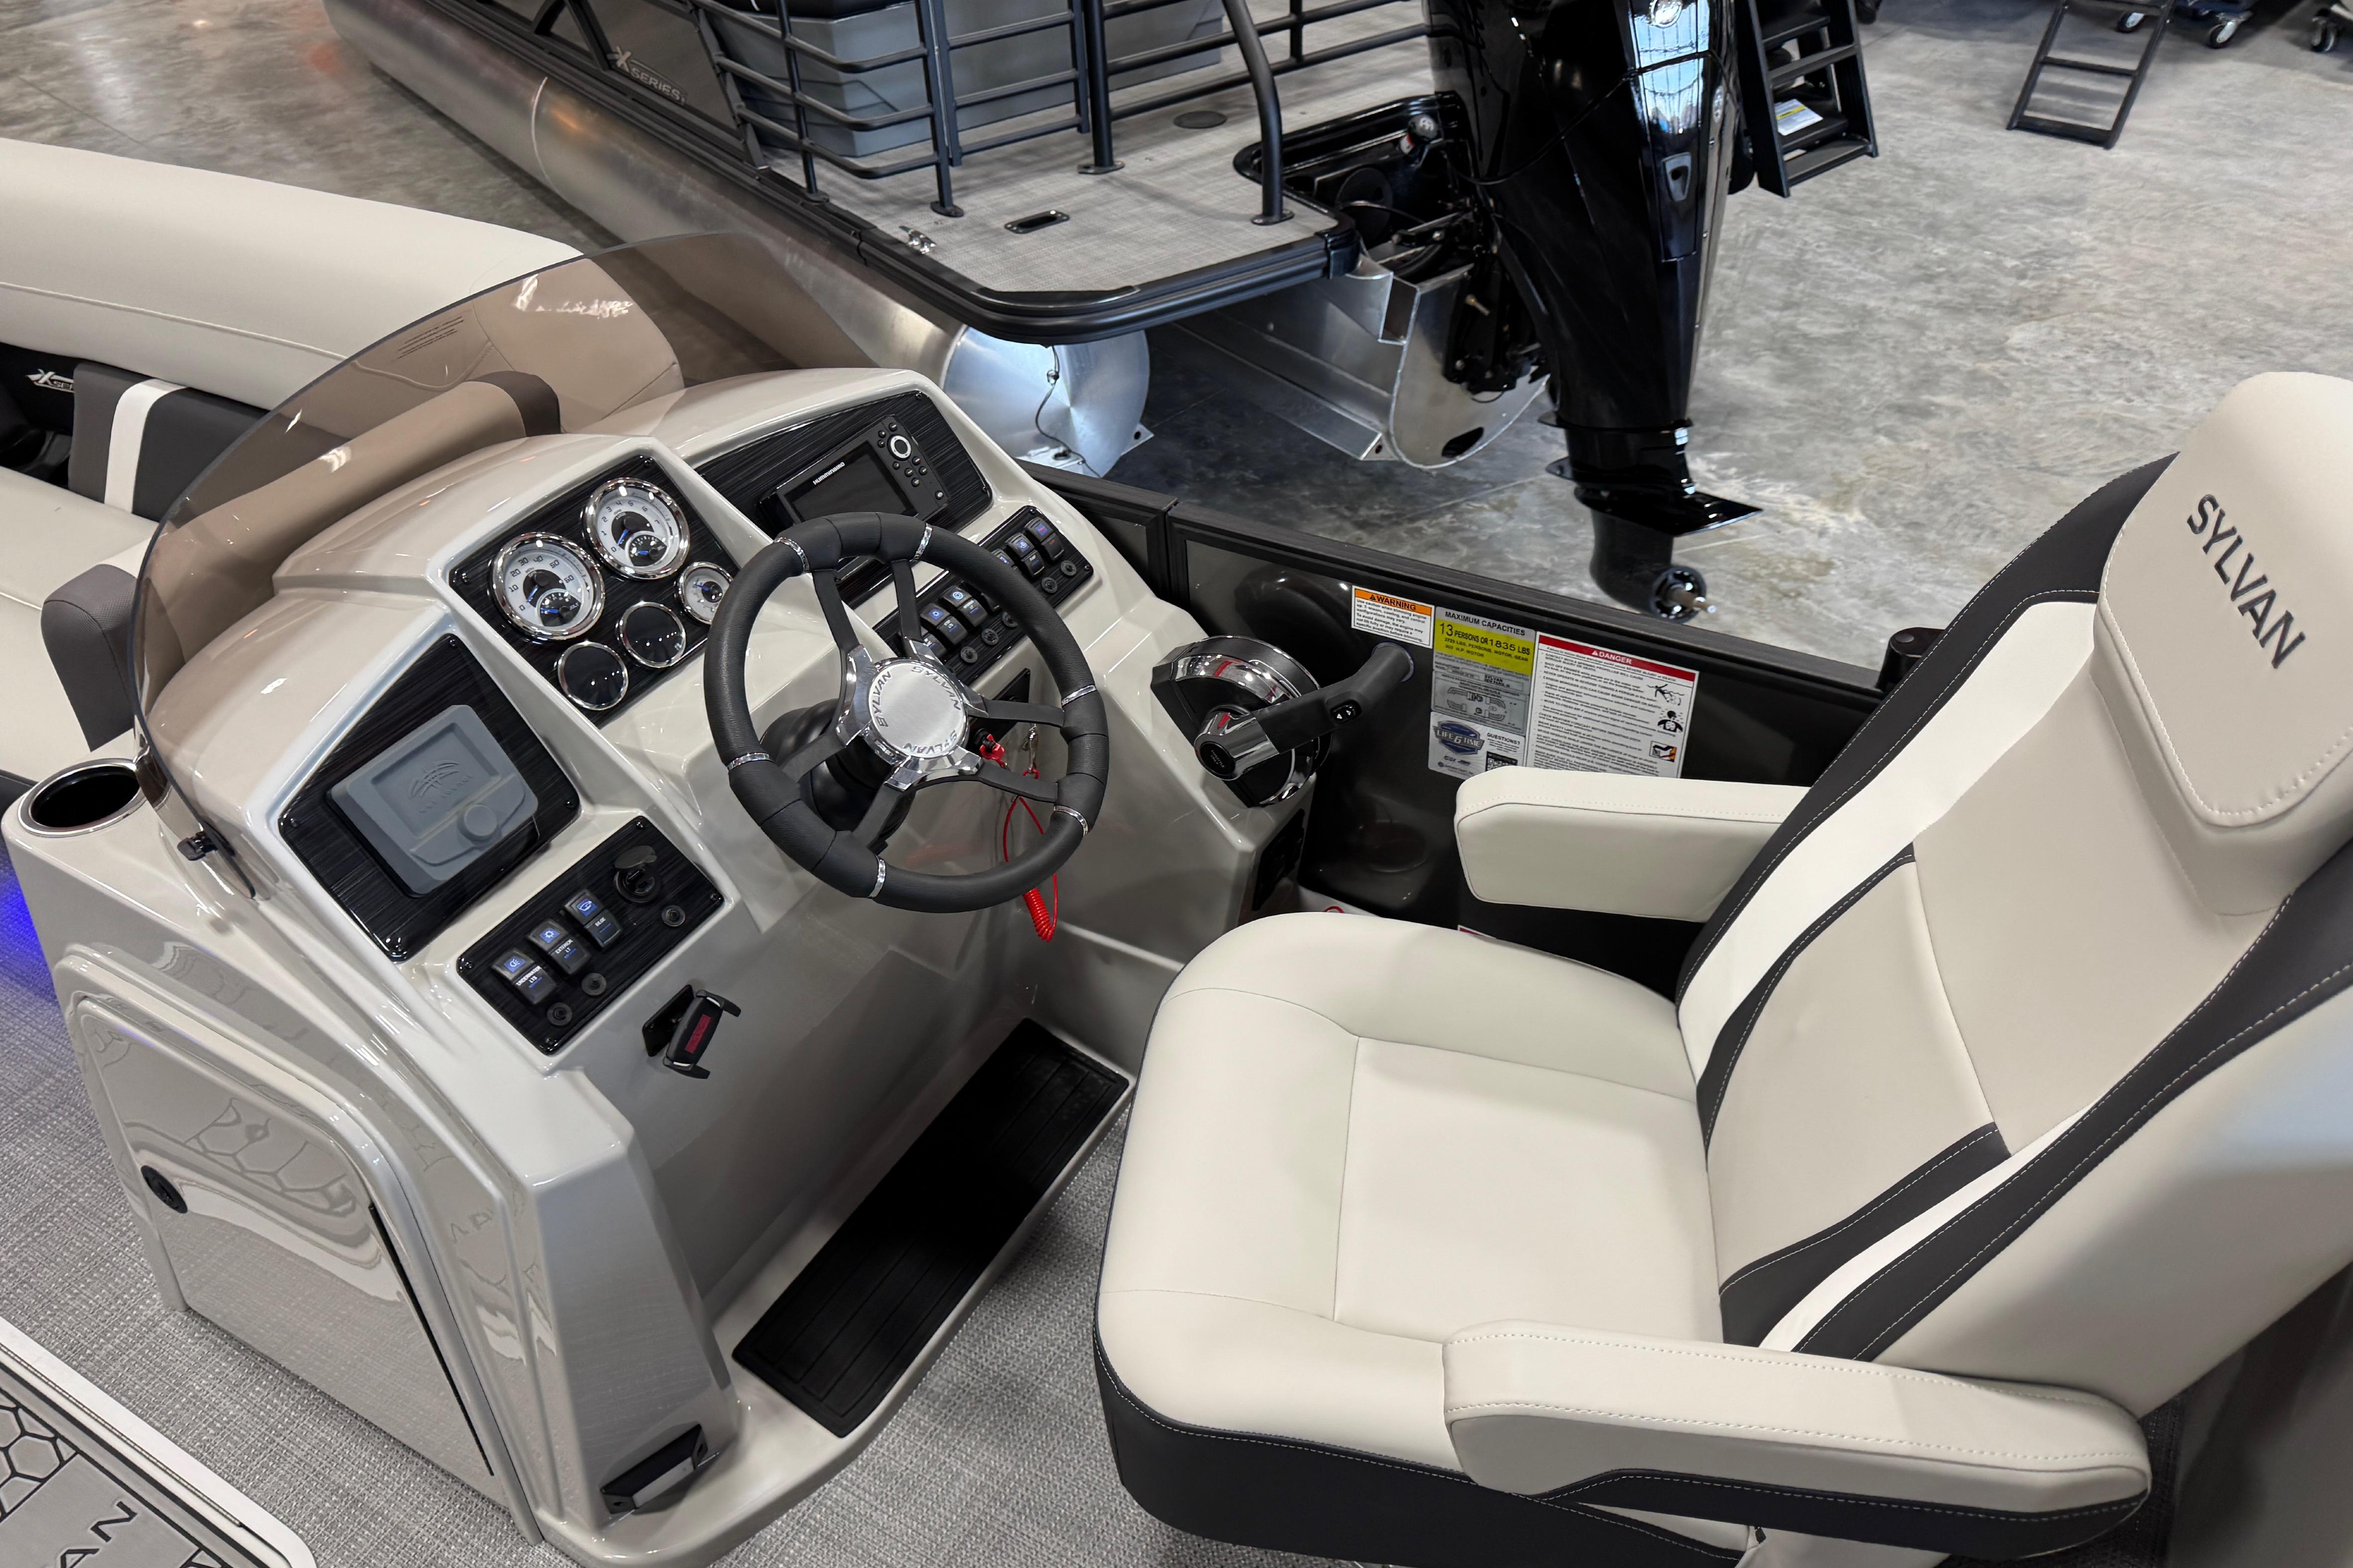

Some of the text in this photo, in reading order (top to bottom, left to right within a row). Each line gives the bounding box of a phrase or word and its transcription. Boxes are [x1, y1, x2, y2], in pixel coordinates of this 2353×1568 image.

[631, 68, 680, 100] SERIES
[813, 462, 845, 485] HUMMINBIRD
[518, 557, 528, 566] 30
[549, 560, 560, 568] 50
[510, 569, 521, 577] 20
[564, 575, 574, 583] 60
[2187, 494, 2306, 669] SYLVAN
[1377, 595, 1416, 610] WARNING
[1445, 611, 1525, 636] MAXIMUM CAPACITIES
[1439, 622, 1453, 636] 13
[1454, 630, 1479, 642] PERSONS
[1489, 639, 1516, 651] 1835
[1518, 646, 1530, 655] LBS
[1598, 651, 1632, 665] DANGER
[911, 666, 961, 710] SYLVAN
[872, 671, 892, 727] SYLVAN
[902, 729, 958, 754] SYLVAN
[1436, 729, 1453, 740] LIFE
[1463, 737, 1480, 747] TIME
[1487, 732, 1520, 745] QUESTIONS?
[595, 917, 606, 927] BILGE
[555, 939, 573, 954] EXTERIOR
[515, 966, 541, 986] UNDERWATER
